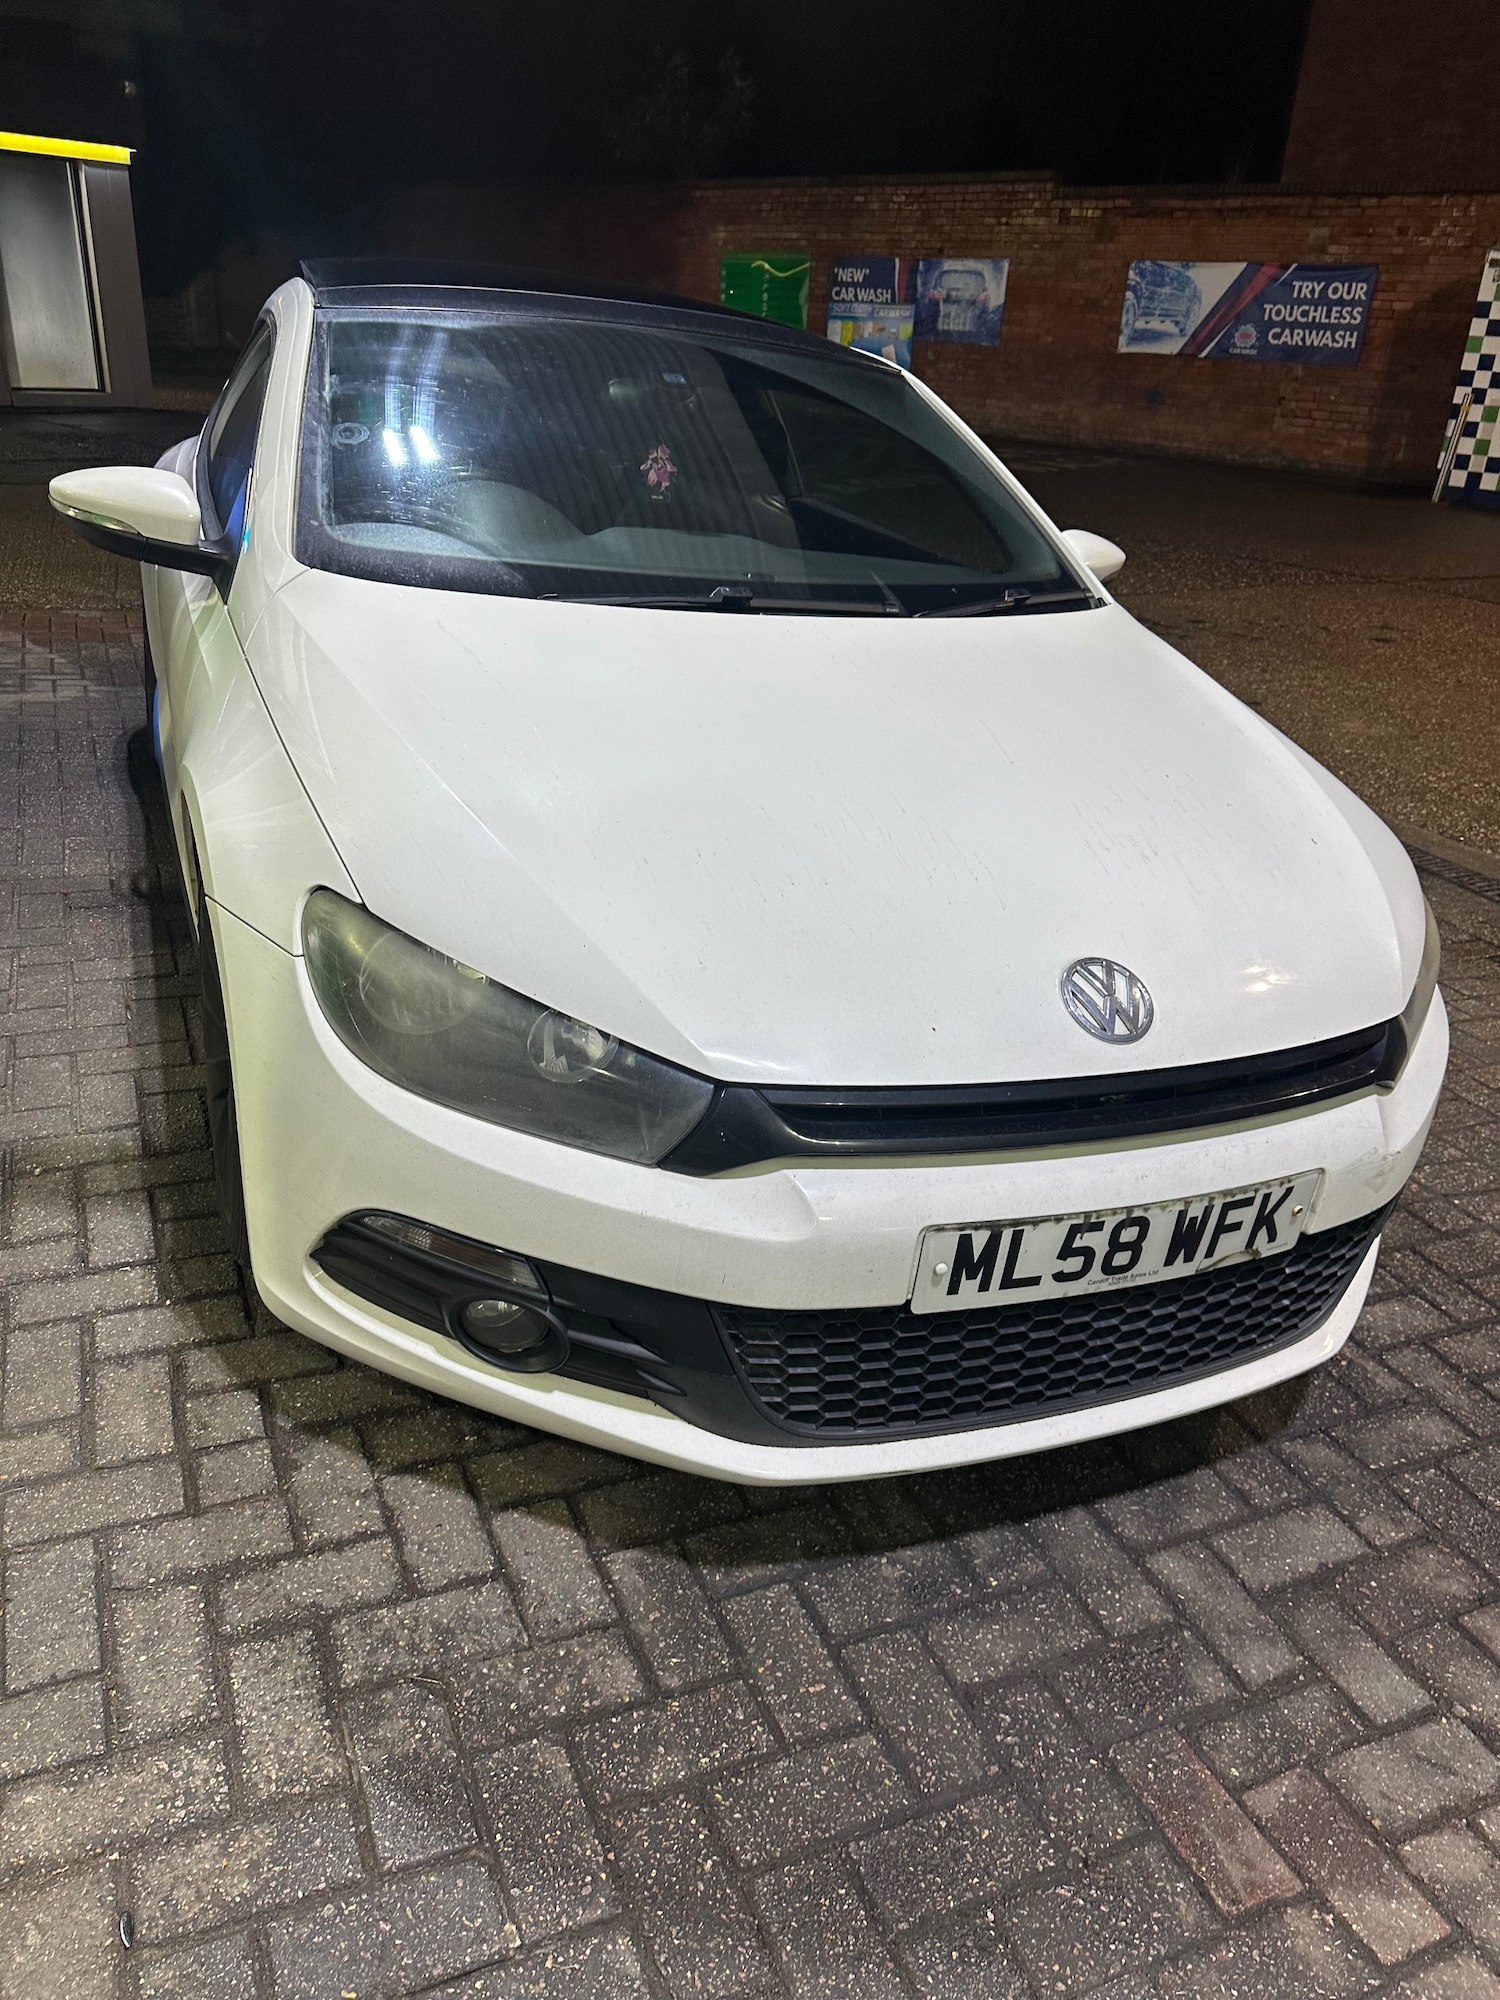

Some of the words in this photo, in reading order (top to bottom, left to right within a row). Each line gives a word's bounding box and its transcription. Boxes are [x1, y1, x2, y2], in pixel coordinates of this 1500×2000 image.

[832, 286, 855, 301] CAR
[857, 287, 891, 303] WASH
[1292, 281, 1325, 299] TRY
[1328, 282, 1368, 300] OUR
[1263, 304, 1363, 324] TOUCHLESS
[1267, 327, 1358, 348] CARWASH
[947, 1215, 1150, 1296] ML58
[1163, 1186, 1295, 1268] WFK
[1087, 1277, 1110, 1286] Cardiff
